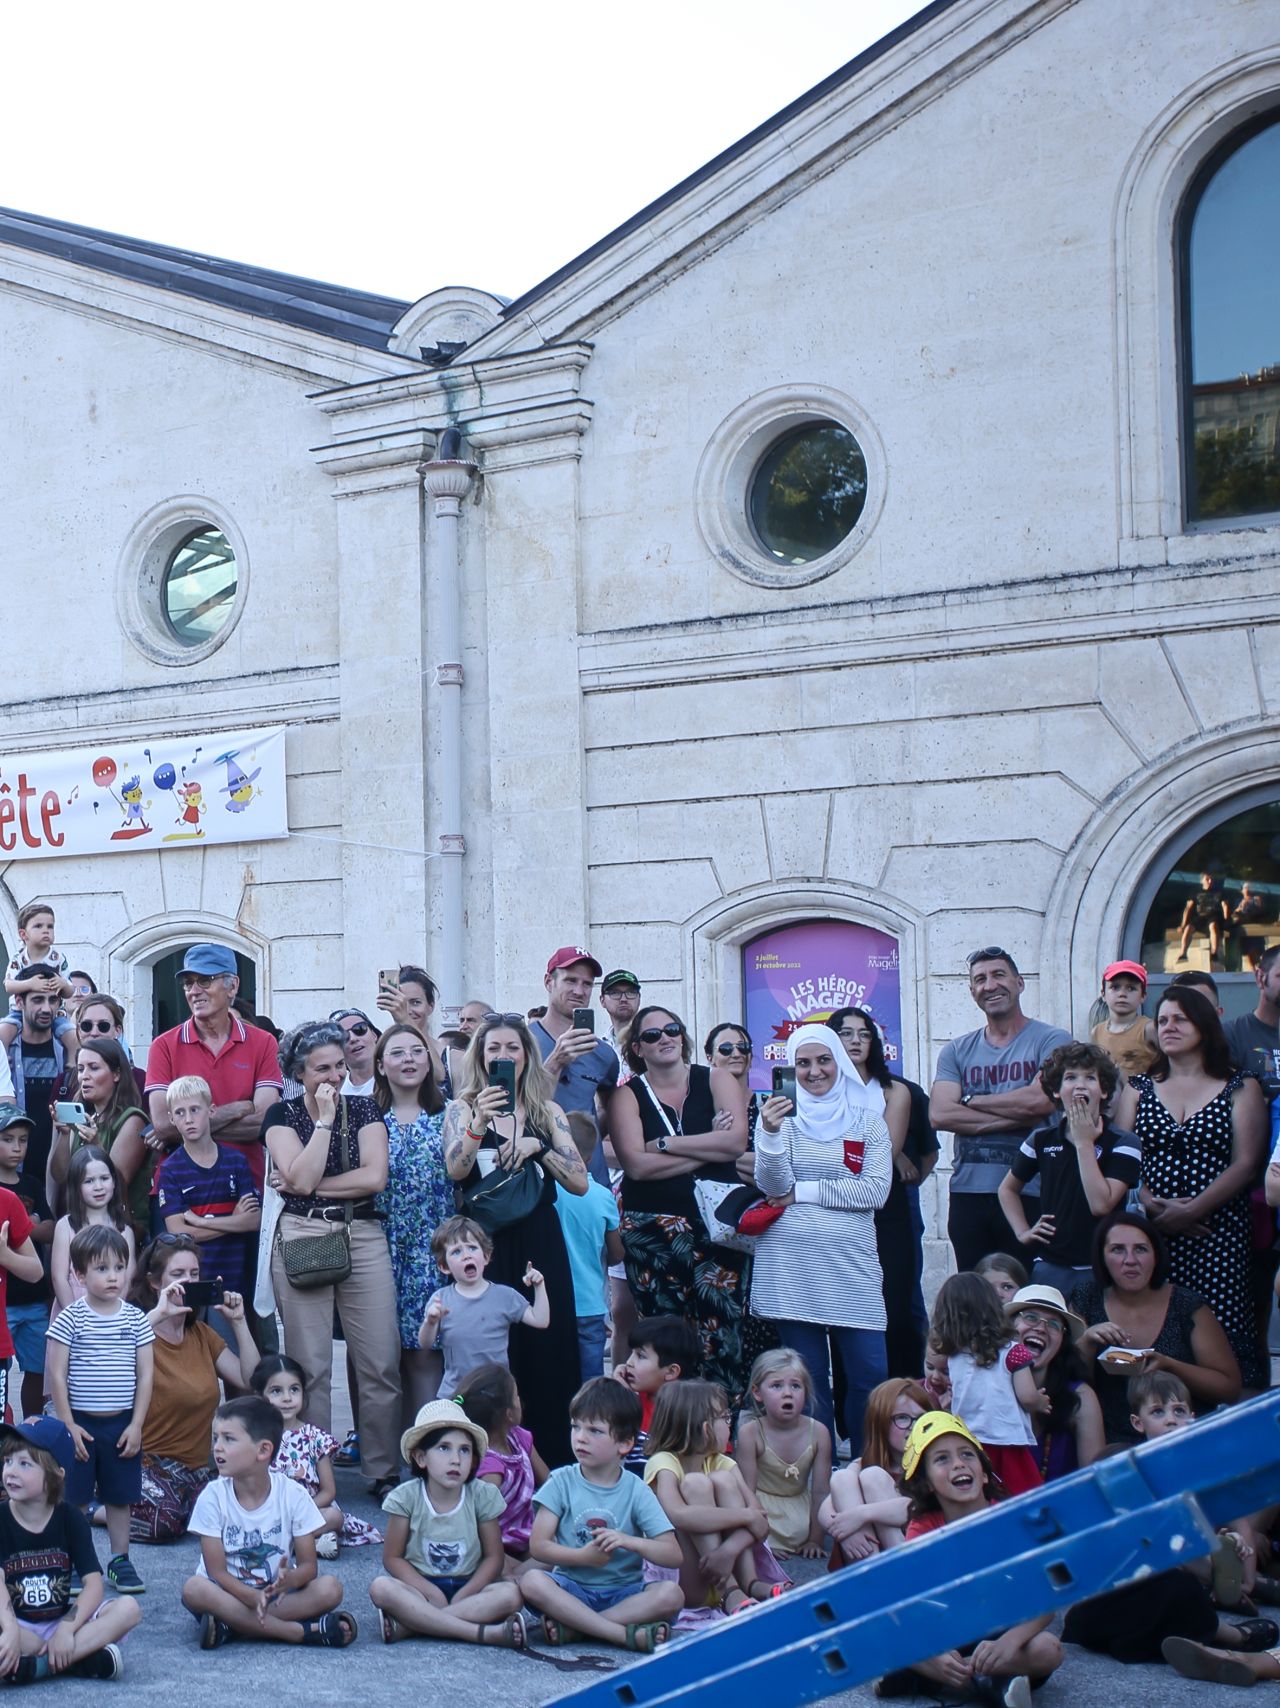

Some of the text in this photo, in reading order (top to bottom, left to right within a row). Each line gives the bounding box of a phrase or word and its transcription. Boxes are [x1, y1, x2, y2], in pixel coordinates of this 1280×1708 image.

[759, 953, 779, 962] juillet
[762, 961, 787, 969] octobre
[868, 949, 899, 971] Mageli
[790, 974, 866, 1000] LES HÉROS
[963, 1060, 1037, 1089] LONDON
[24, 1578, 47, 1587] ROUTE
[27, 1589, 48, 1604] 66
